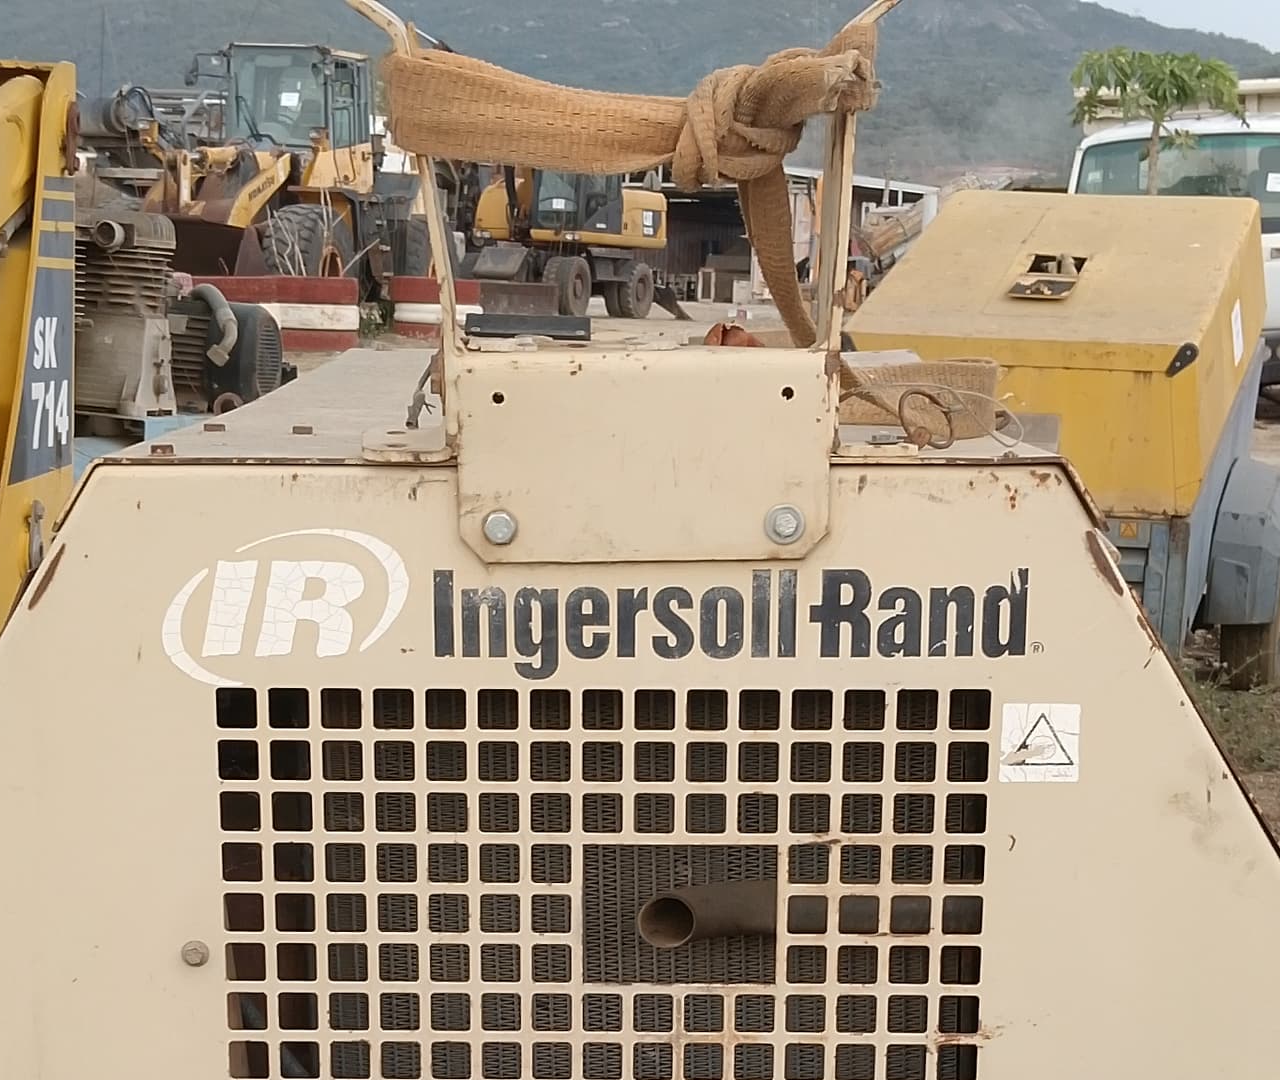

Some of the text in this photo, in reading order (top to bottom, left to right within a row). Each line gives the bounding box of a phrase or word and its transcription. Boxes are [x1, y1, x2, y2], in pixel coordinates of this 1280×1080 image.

[33, 316, 58, 369] SK
[31, 379, 69, 450] 714
[201, 559, 365, 657] IR
